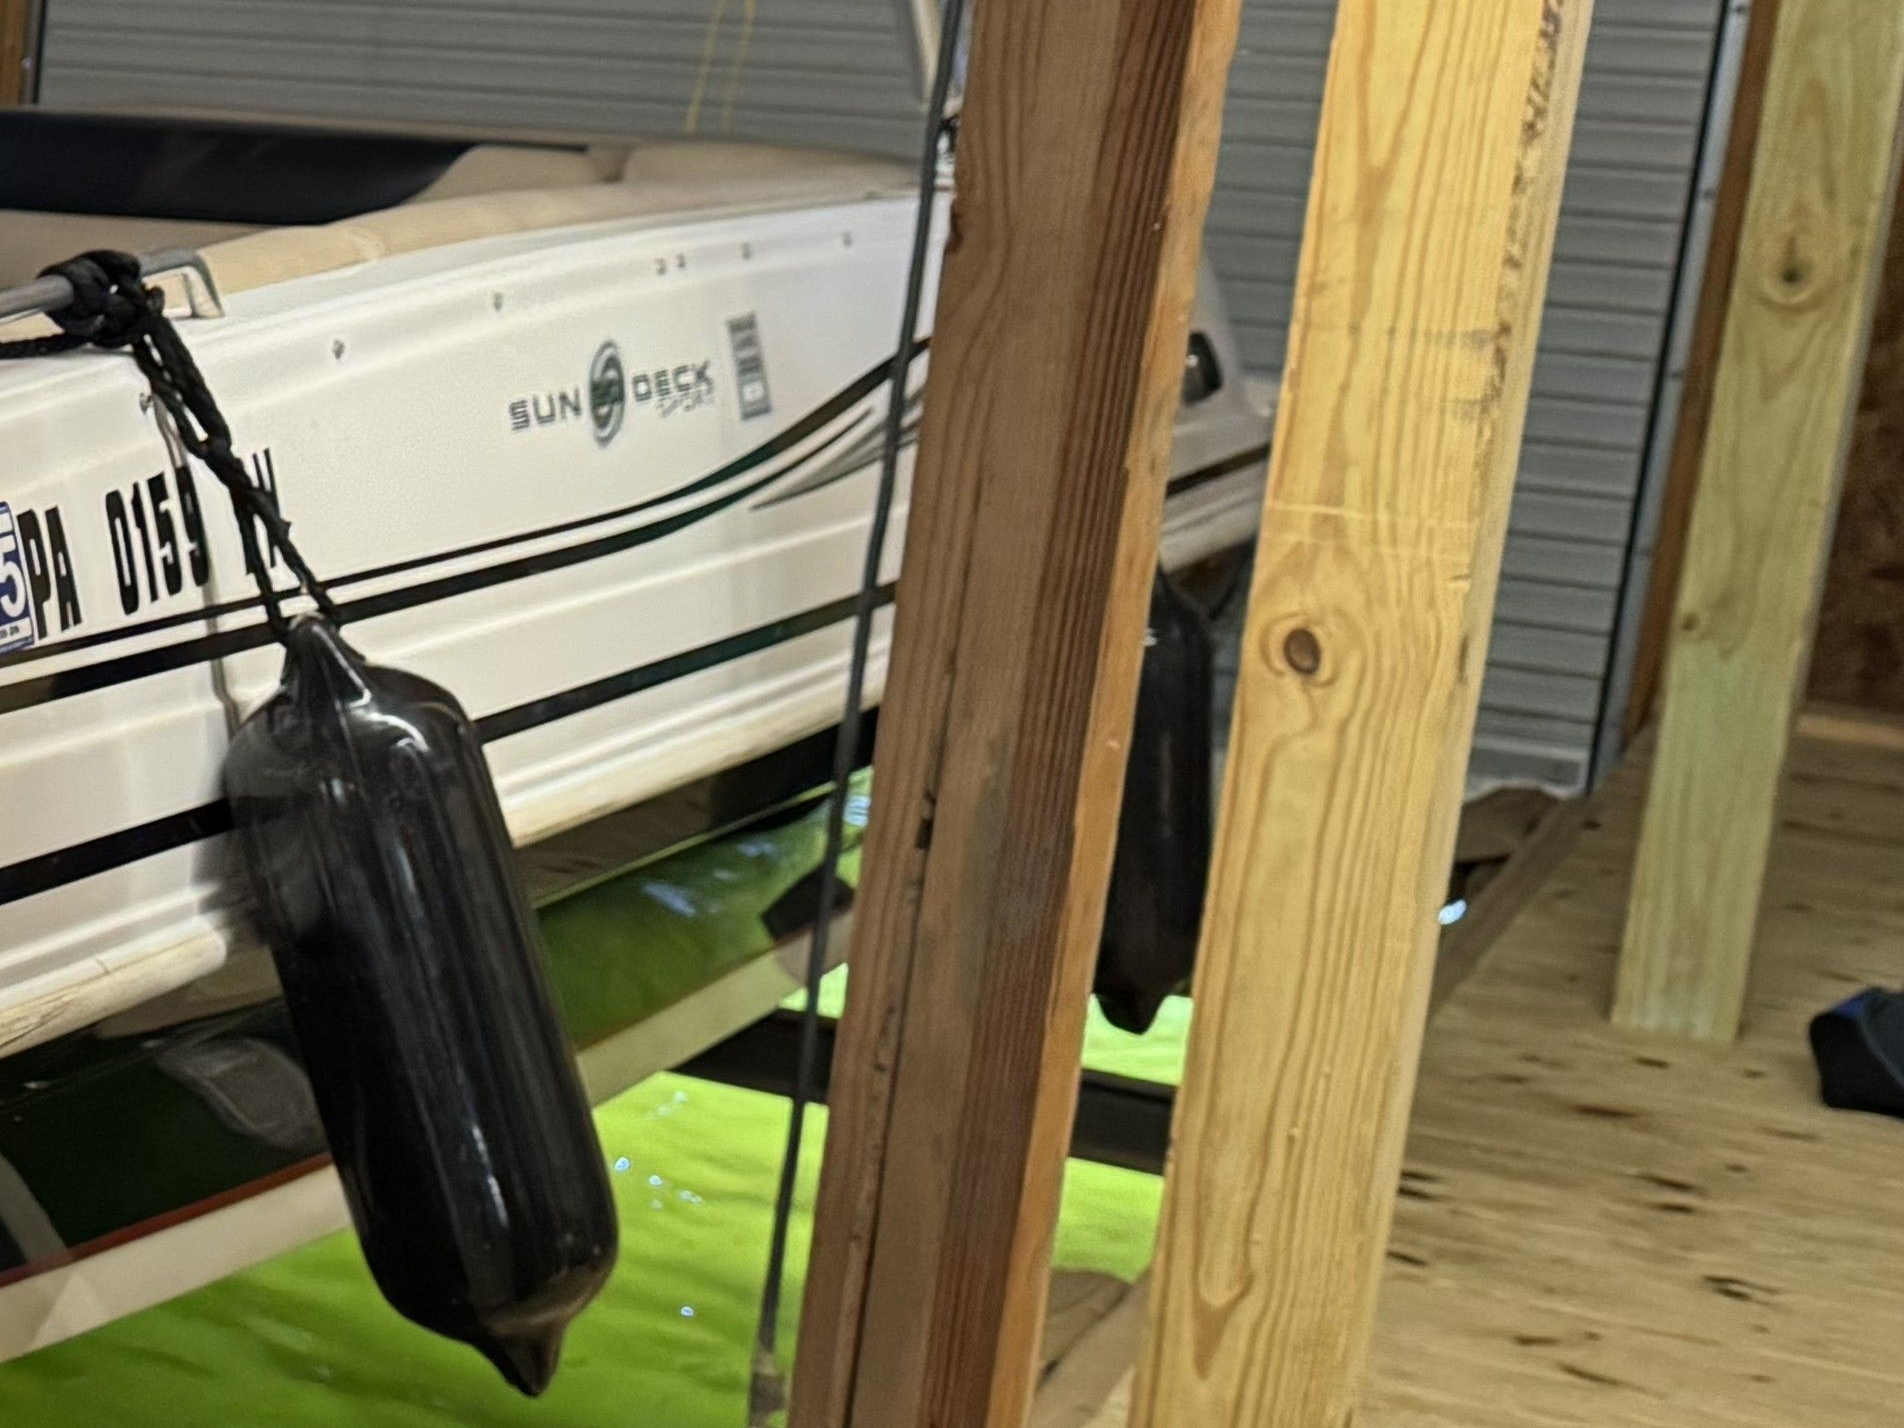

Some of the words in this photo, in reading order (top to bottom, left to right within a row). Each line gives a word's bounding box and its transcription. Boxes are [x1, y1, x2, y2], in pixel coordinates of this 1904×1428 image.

[509, 387, 582, 430] SUN
[632, 360, 714, 403] DECK
[17, 505, 83, 640] PA
[105, 467, 210, 616] 0159
